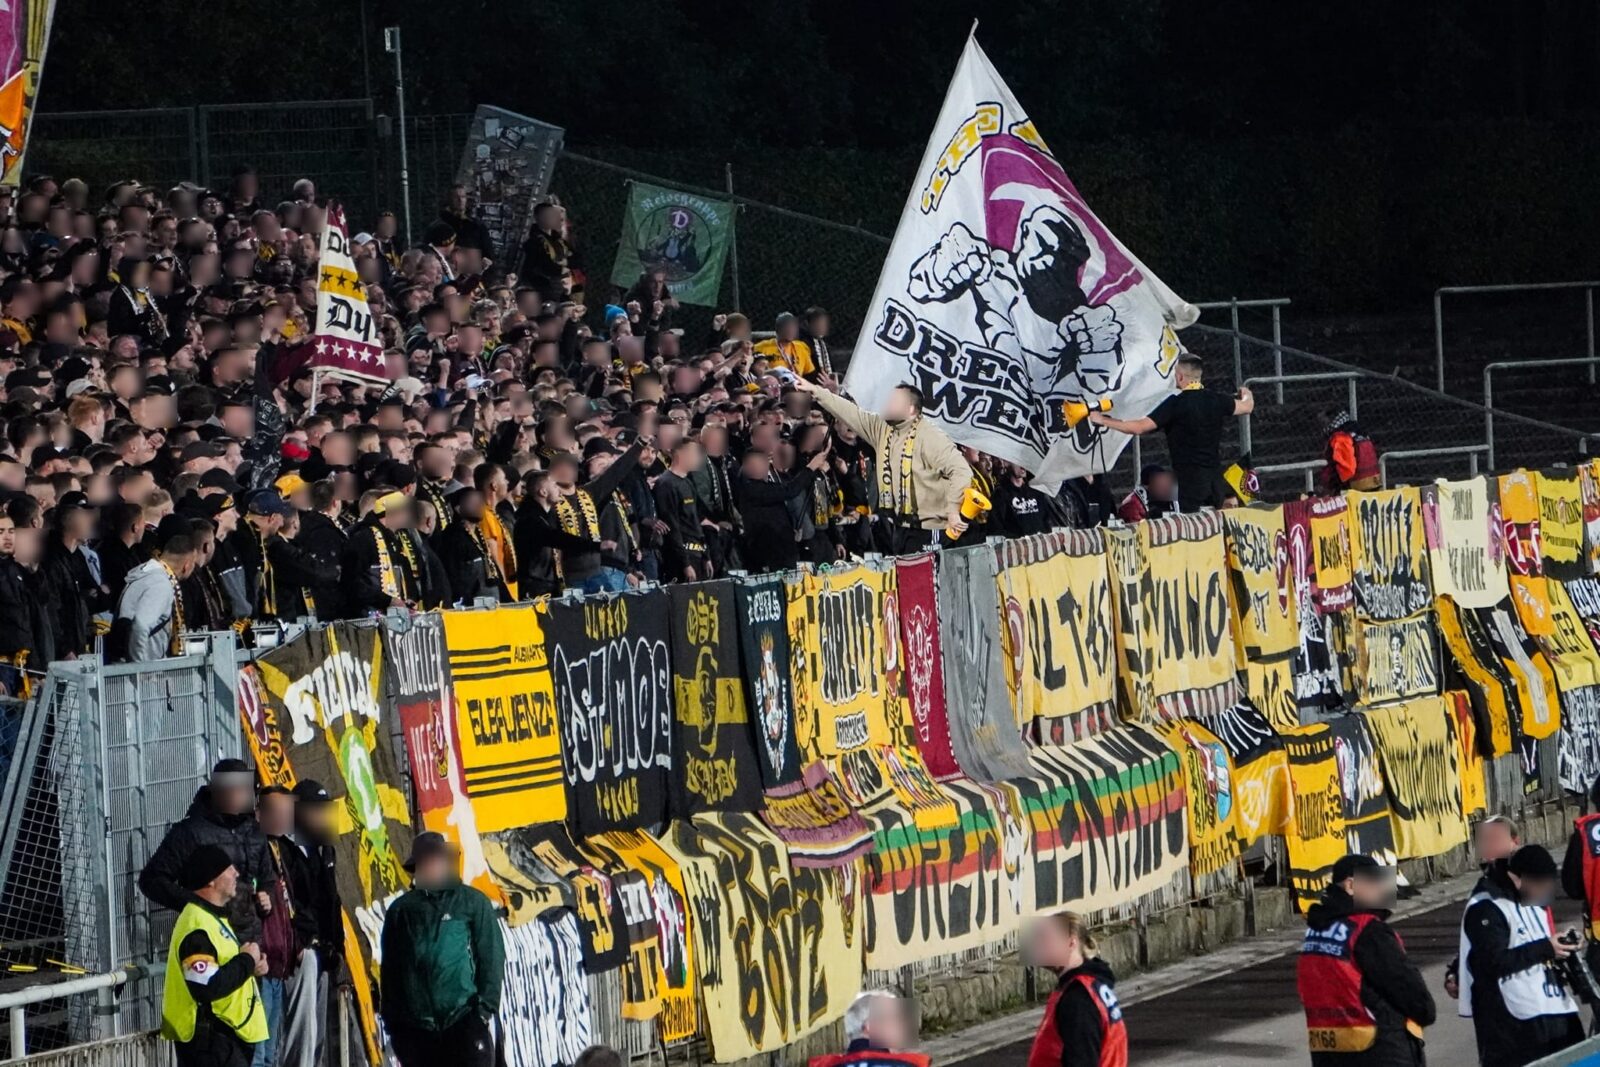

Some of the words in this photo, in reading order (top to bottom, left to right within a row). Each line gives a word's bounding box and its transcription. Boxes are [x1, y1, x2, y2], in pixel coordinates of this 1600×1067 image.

[920, 101, 1003, 214] THE
[284, 651, 380, 744] FREITAL
[735, 898, 829, 1051] BOYZ
